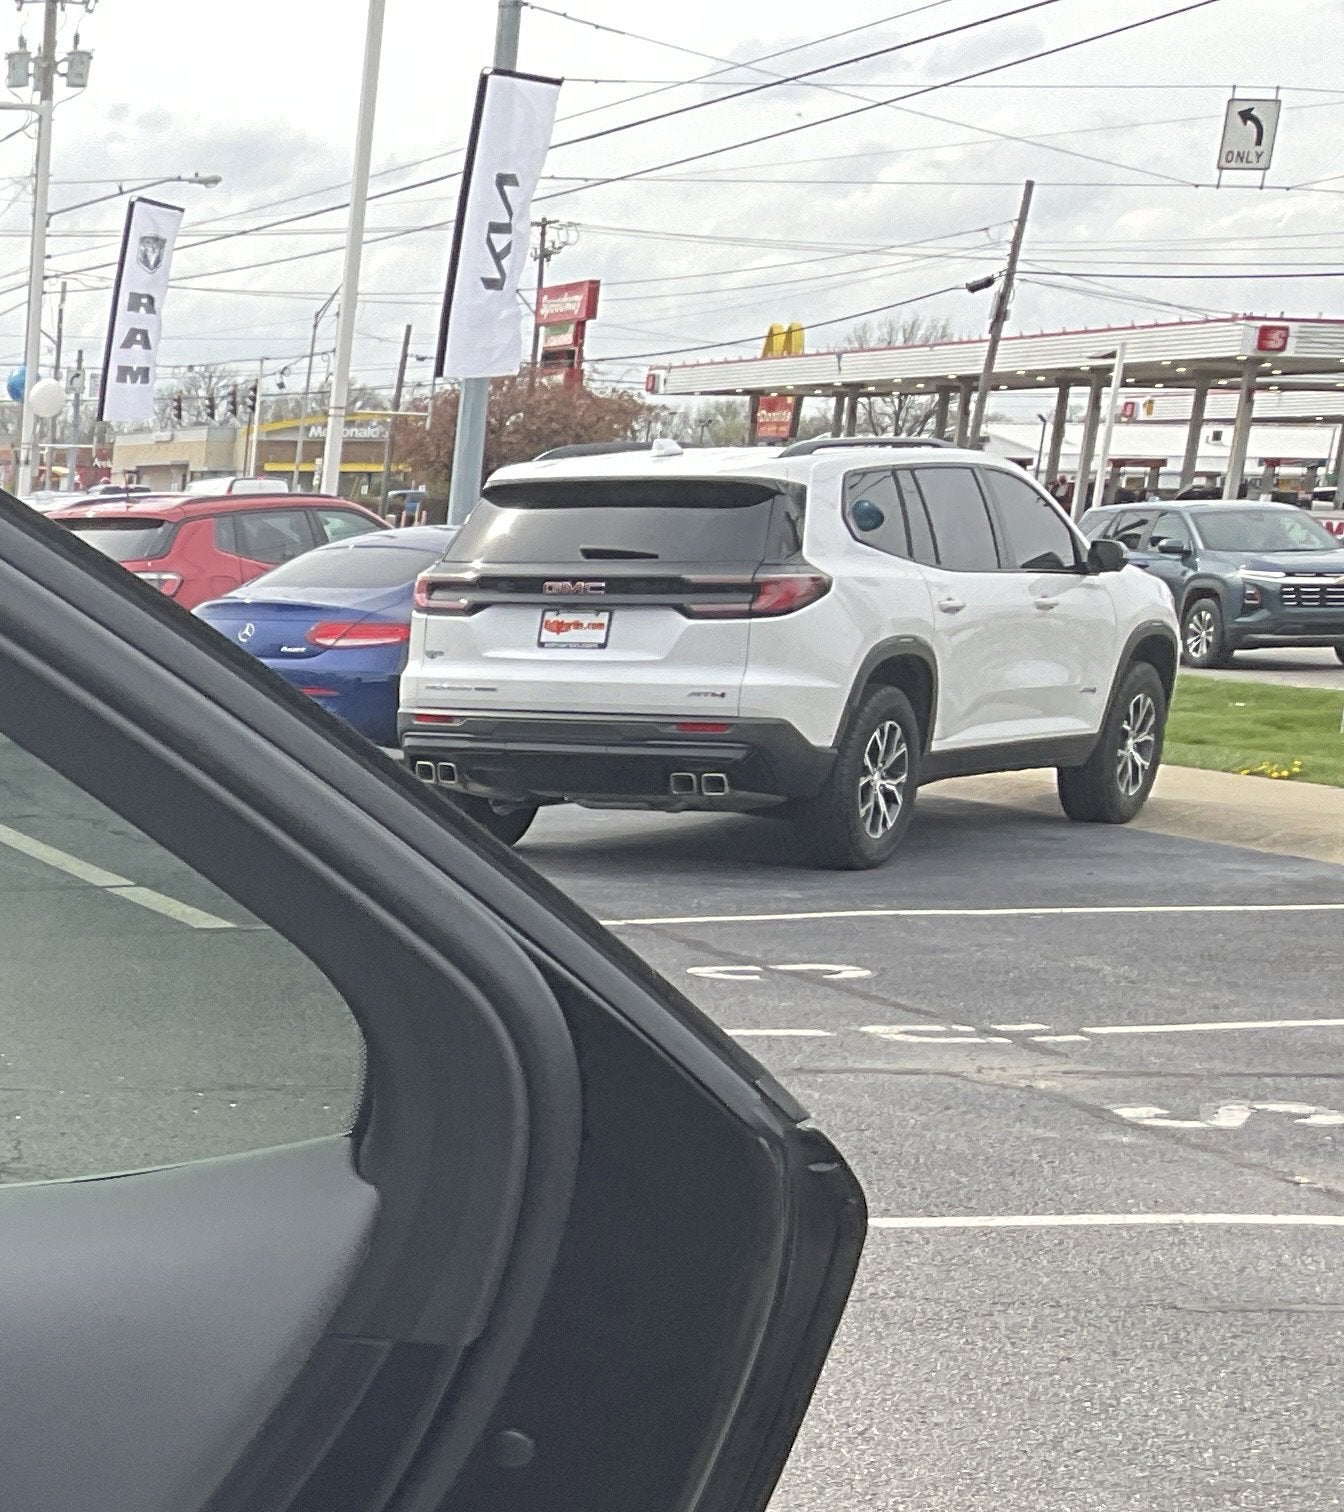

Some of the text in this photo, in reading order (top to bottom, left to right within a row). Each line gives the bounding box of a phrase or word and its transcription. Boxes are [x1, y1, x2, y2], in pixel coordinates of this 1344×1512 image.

[1224, 150, 1264, 164] ONLY
[115, 292, 157, 384] RAM
[543, 581, 606, 595] GMC
